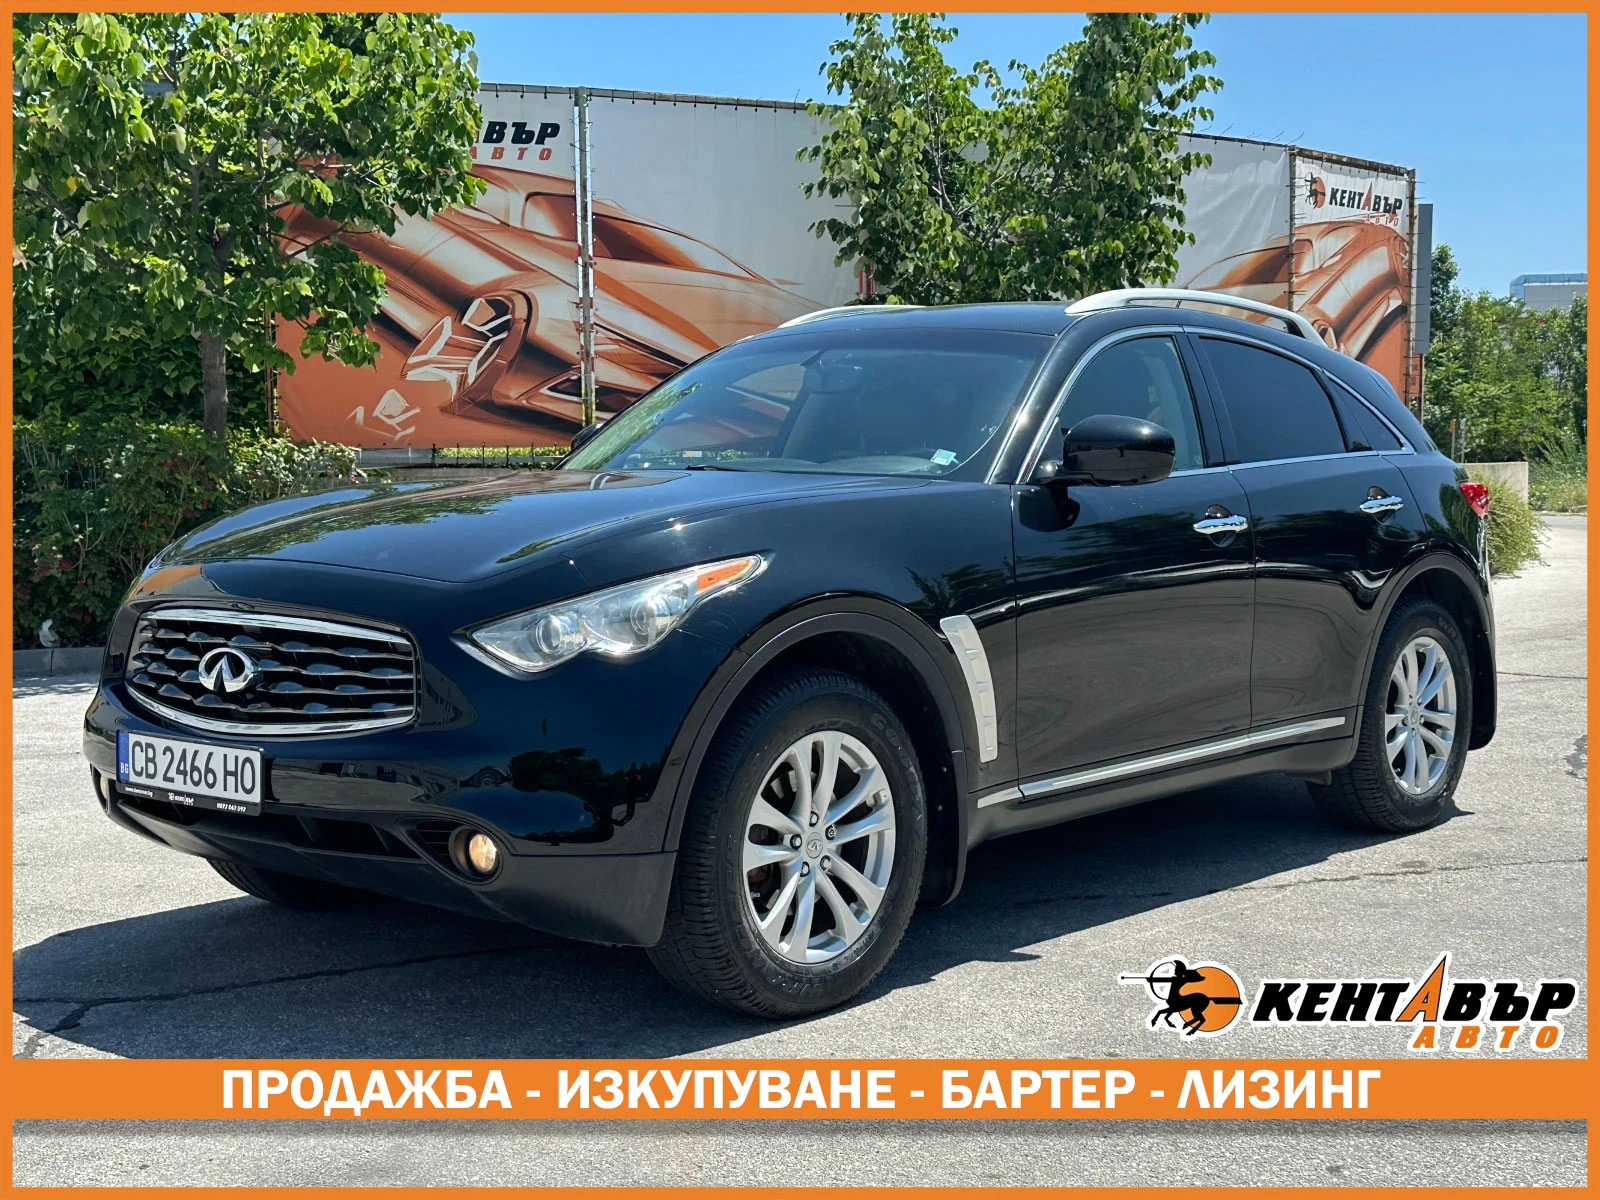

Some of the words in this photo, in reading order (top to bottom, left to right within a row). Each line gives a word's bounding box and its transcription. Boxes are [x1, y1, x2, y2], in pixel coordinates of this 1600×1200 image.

[1329, 181, 1403, 215] КЕНТАВЪР
[120, 762, 129, 774] BG
[131, 740, 158, 780] CB
[162, 745, 218, 790] 2466
[223, 753, 256, 795] HO
